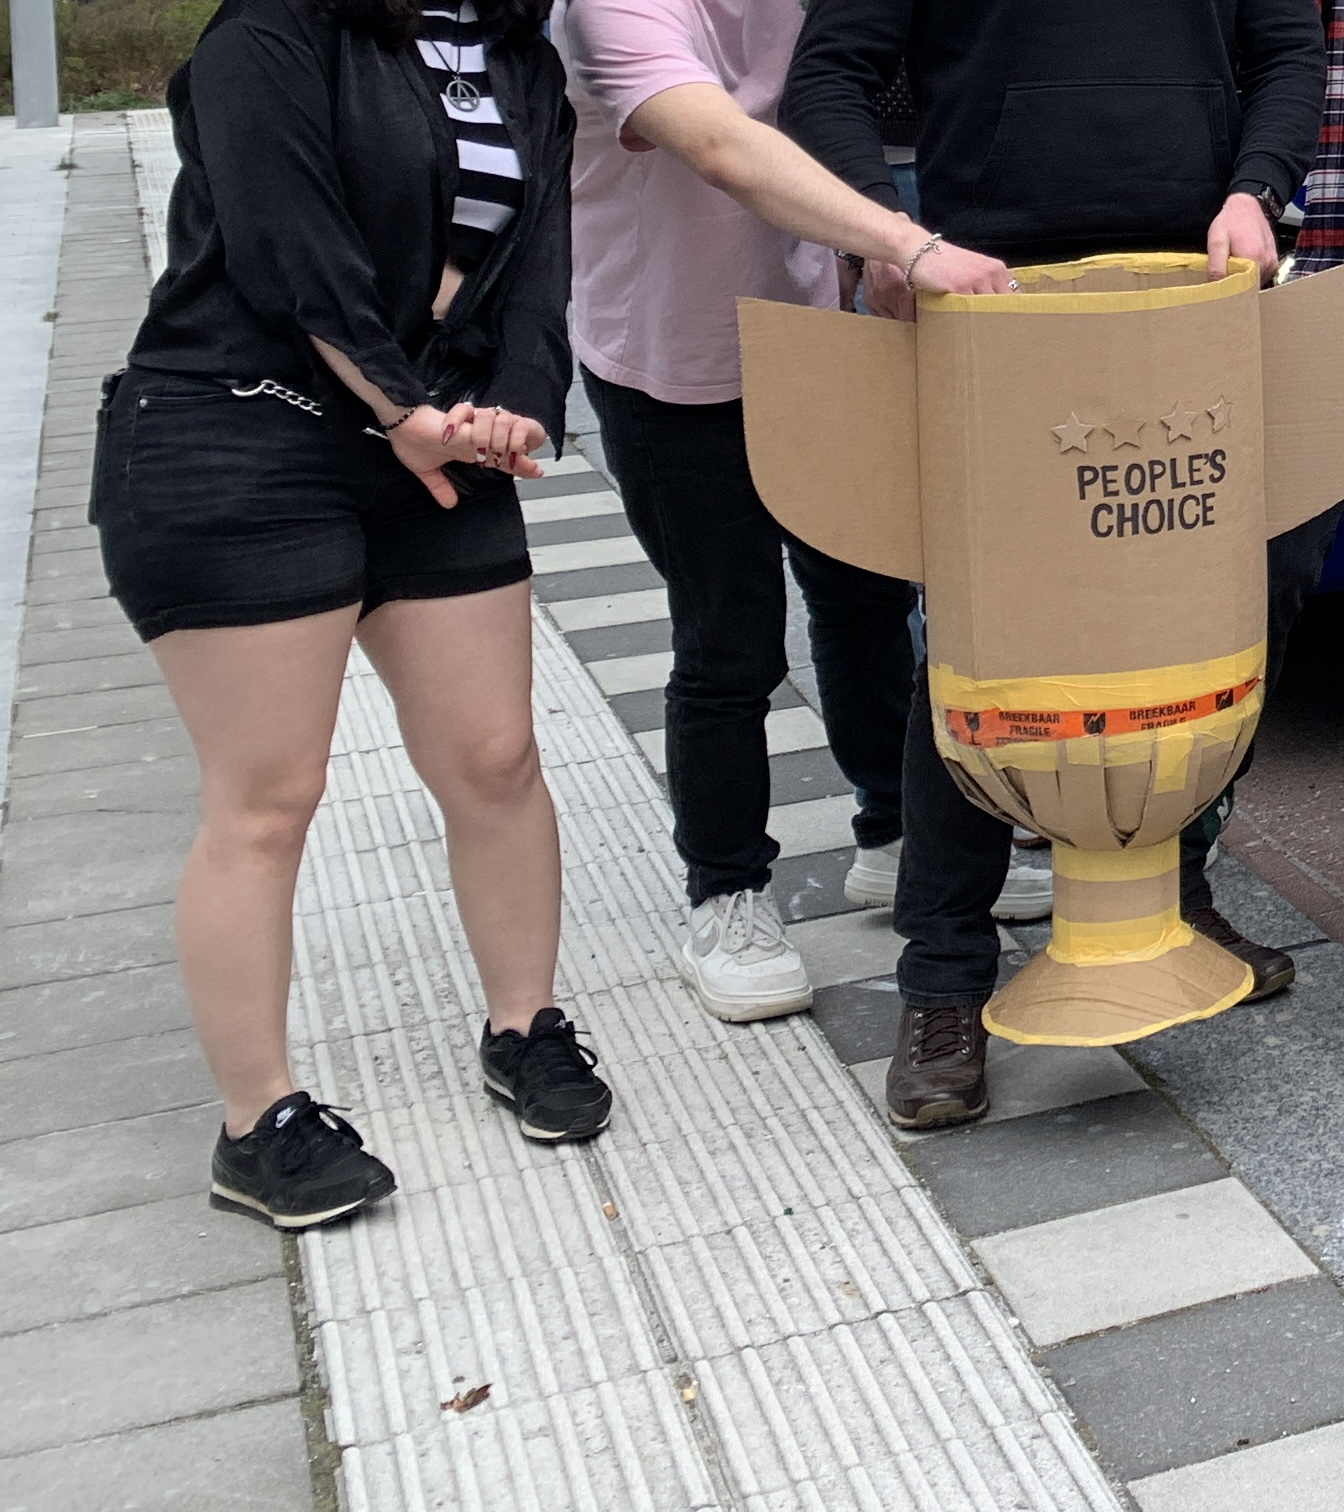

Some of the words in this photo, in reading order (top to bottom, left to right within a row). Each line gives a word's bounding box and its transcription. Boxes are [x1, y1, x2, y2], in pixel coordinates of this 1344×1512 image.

[1077, 449, 1226, 500] PEOPLE'S
[1090, 492, 1215, 538] CHOICE
[1130, 701, 1196, 721] BREEKBAAR
[1009, 725, 1050, 737] FRAGILE
